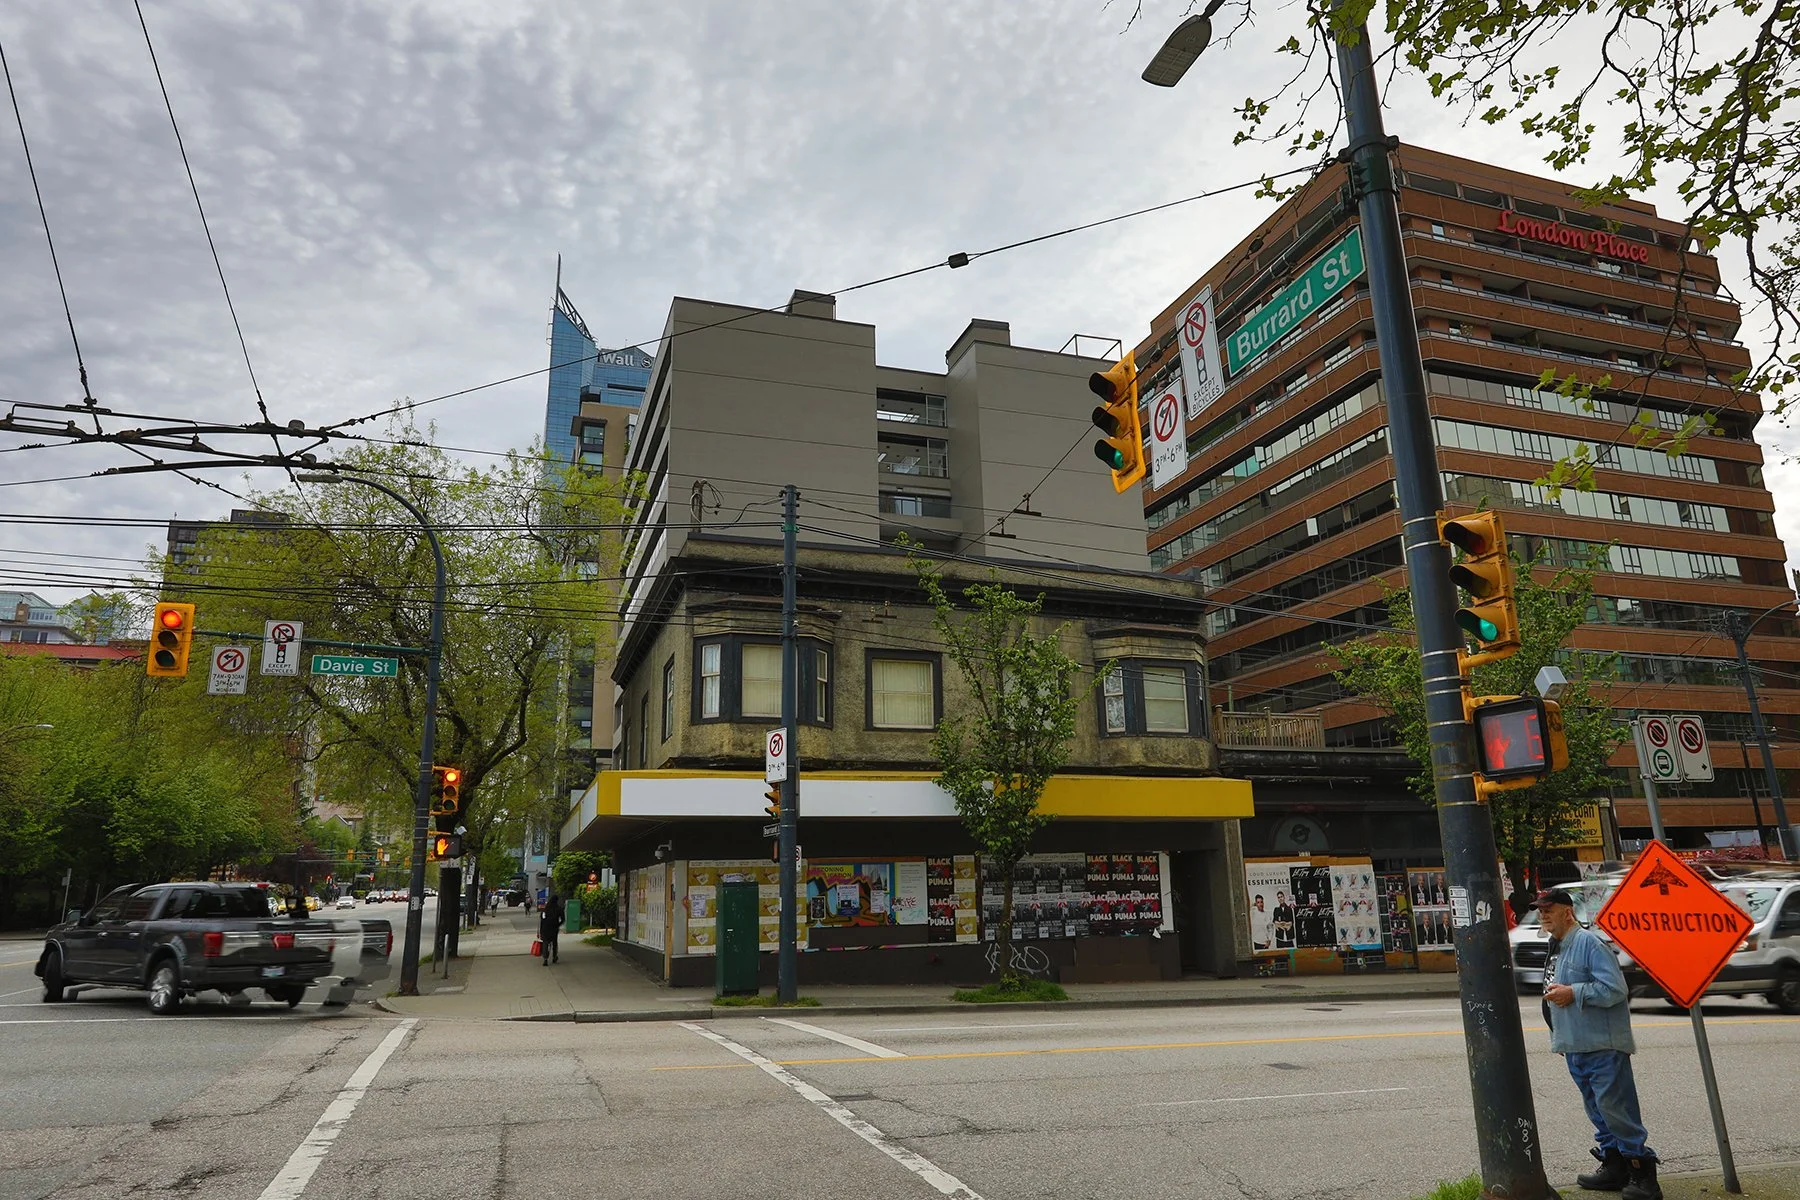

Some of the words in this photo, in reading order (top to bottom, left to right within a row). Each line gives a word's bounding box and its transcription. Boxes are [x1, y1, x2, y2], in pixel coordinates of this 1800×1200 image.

[1496, 209, 1587, 250] London
[1590, 230, 1649, 264] Place
[1236, 277, 1315, 361] Burrard
[1322, 250, 1352, 291] St
[602, 353, 635, 367] Wall
[1193, 376, 1216, 402] EXCEPT
[1192, 385, 1220, 413] BICYCLES
[320, 659, 365, 673] Davie
[372, 661, 390, 674] St
[928, 857, 951, 866] BLACK
[1087, 855, 1108, 863] BLACK
[1112, 854, 1133, 862] BLACK
[1137, 855, 1157, 863] BLACK
[1087, 873, 1110, 881] PUMAS
[1112, 873, 1134, 881] PUMAS
[1137, 874, 1159, 882] PUMAS
[928, 878, 953, 886] PUMAS
[1248, 878, 1290, 886] ESSENTIALS
[1090, 913, 1112, 921] PUMAS
[1114, 912, 1137, 920] PUMAS
[1139, 911, 1161, 919] PUMAS
[929, 917, 954, 926] PUMAS
[1607, 912, 1739, 933] CONSTRUCTION
